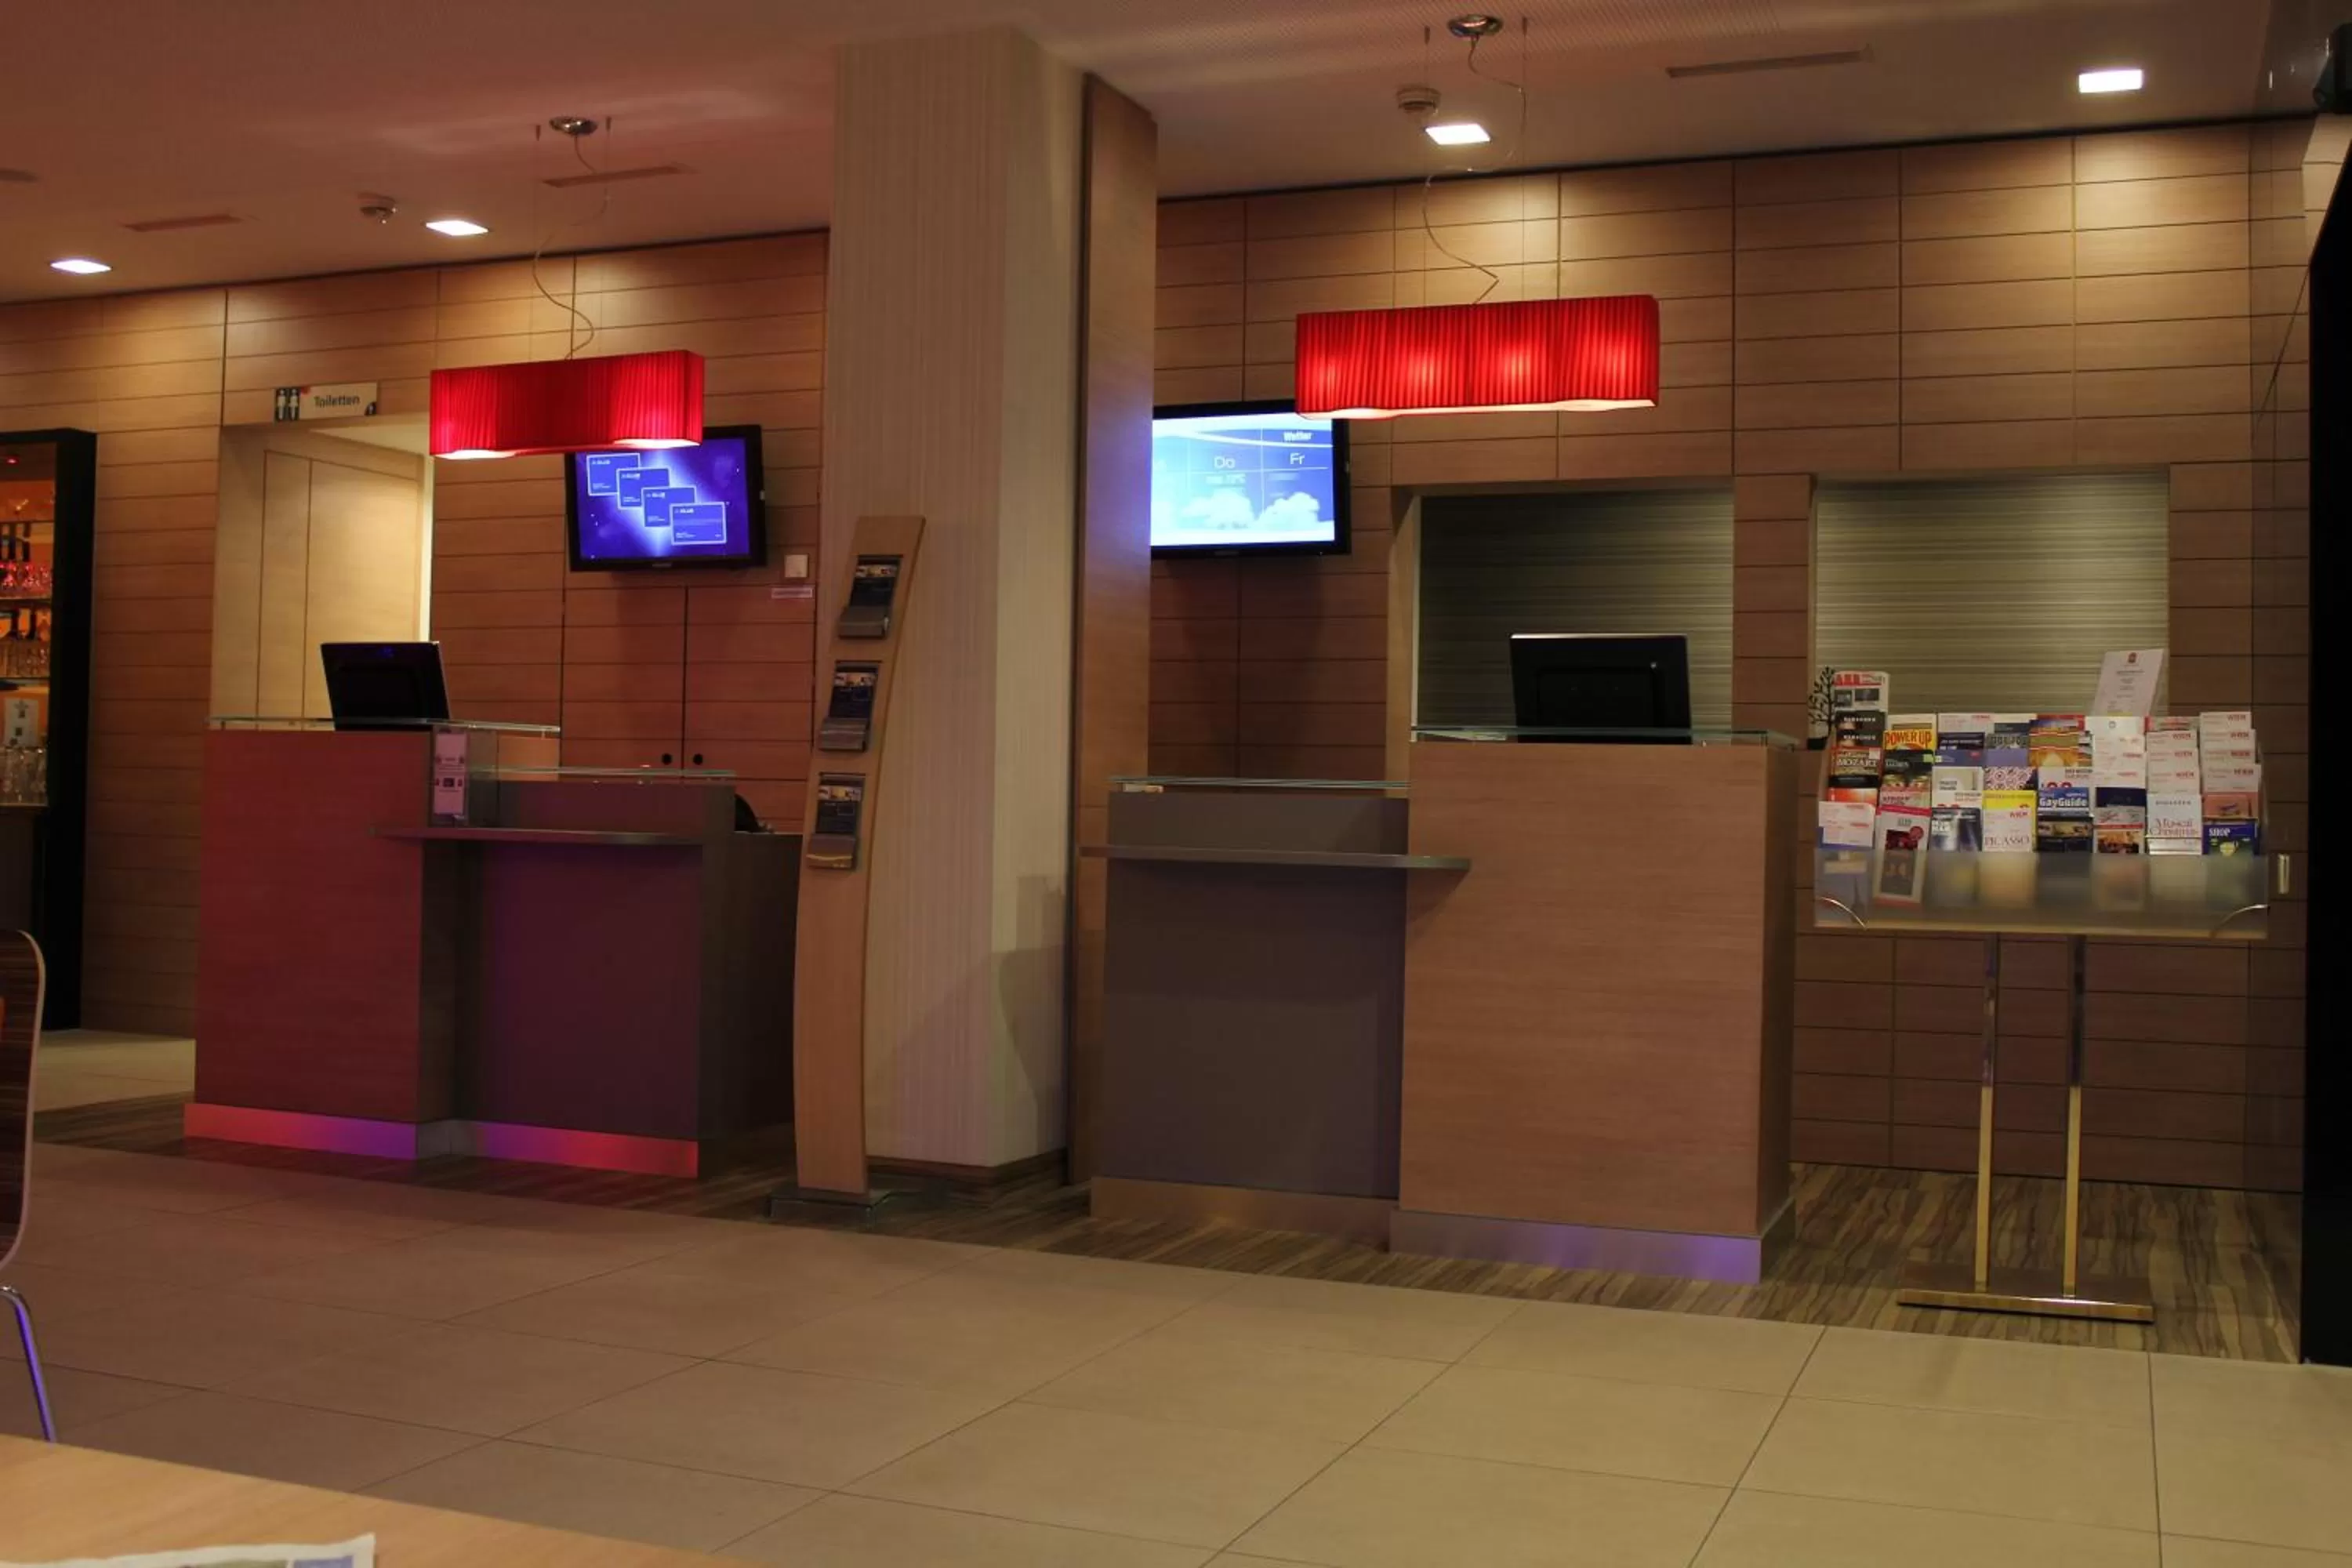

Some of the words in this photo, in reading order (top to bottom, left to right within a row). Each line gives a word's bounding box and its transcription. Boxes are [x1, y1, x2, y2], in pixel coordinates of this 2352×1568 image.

[314, 394, 361, 408] Toiletten
[1214, 456, 1236, 468] Do
[1290, 452, 1305, 464] Fr
[1885, 731, 1918, 745] POWER
[1918, 731, 1933, 746] UP
[1836, 758, 1877, 767] MOZART
[2039, 797, 2088, 808] GayGuide
